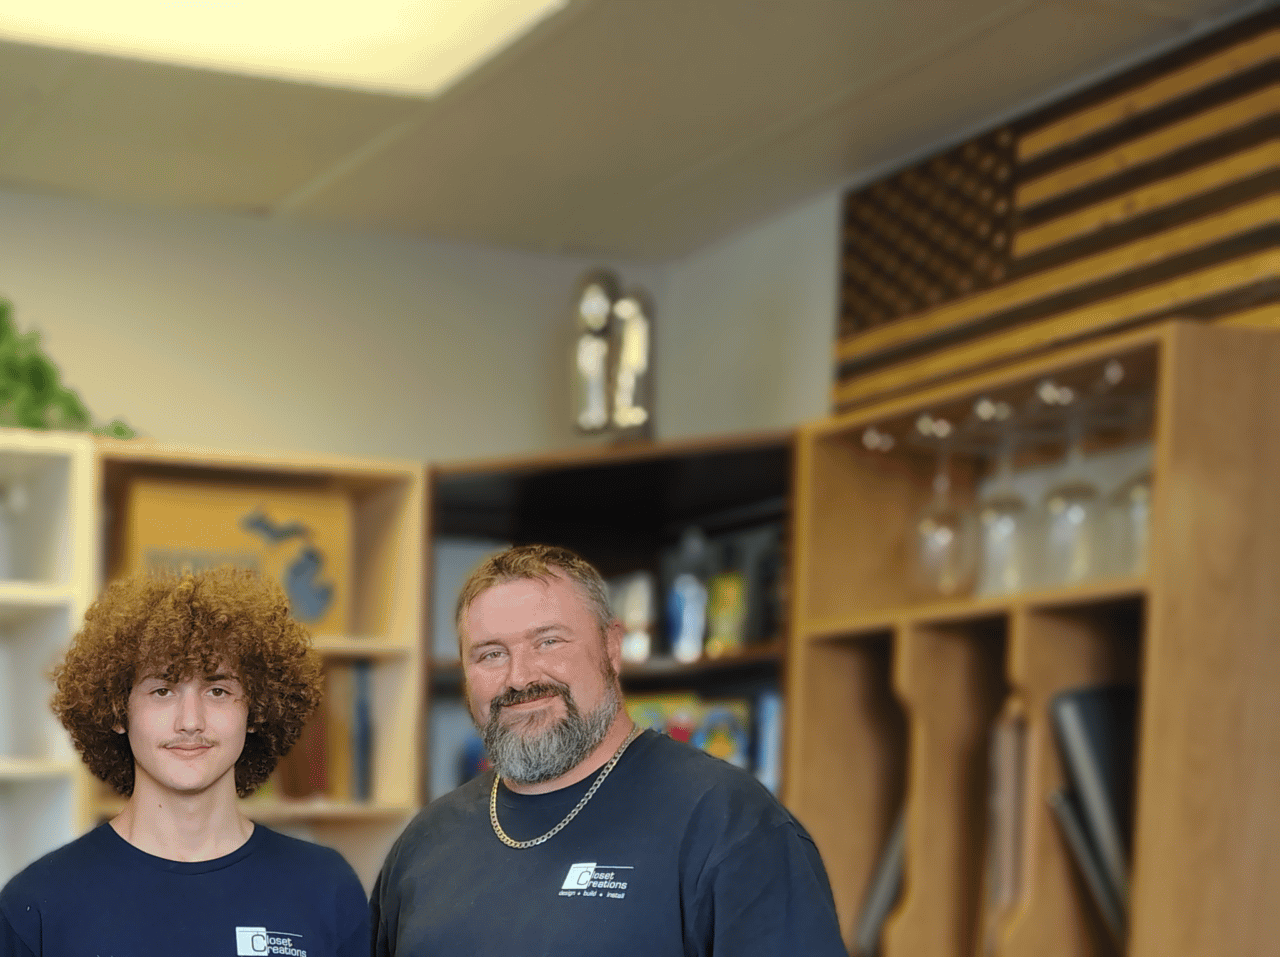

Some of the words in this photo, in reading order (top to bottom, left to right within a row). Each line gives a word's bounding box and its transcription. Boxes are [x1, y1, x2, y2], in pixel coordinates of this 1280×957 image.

[577, 870, 615, 883] Closet
[577, 877, 628, 890] Creations
[251, 934, 293, 950] Closet
[251, 943, 307, 957] Creations
